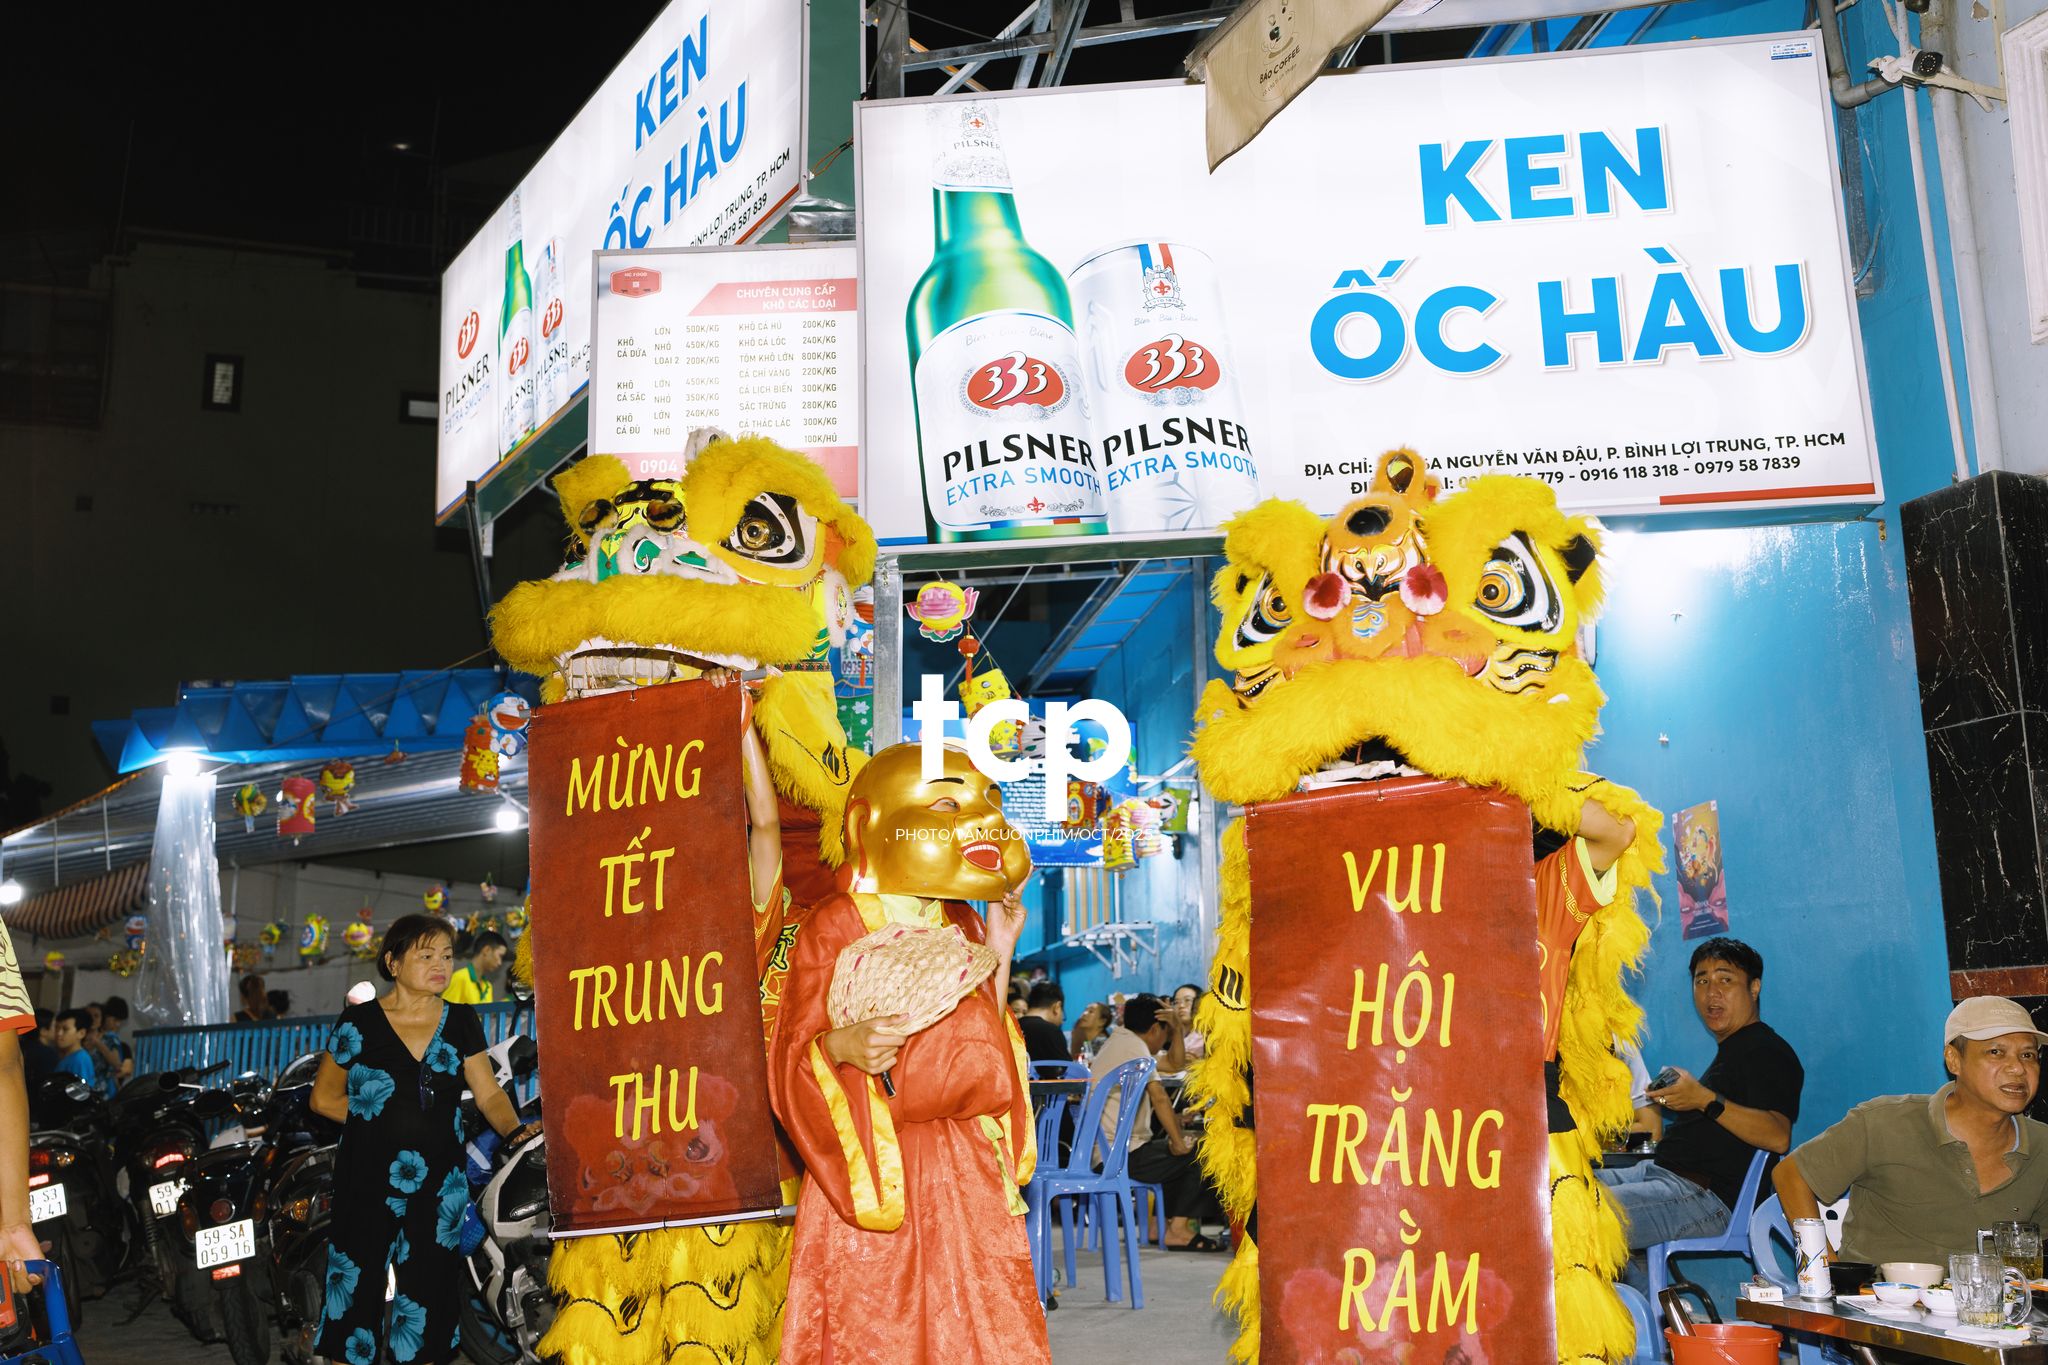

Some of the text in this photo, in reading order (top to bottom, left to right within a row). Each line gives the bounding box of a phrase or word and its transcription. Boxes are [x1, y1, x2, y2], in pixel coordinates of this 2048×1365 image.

[1274, 44, 1300, 74] COFFEE
[636, 14, 707, 151] KEN
[663, 81, 746, 226] HÀU
[770, 147, 790, 178] HCM
[1419, 126, 1668, 226] KEN
[738, 208, 751, 230] 587
[753, 193, 768, 215] 839
[736, 282, 836, 298] CHUYÊN CUNG CẤP
[811, 298, 836, 310] LOẠI
[802, 319, 836, 329] 200K/KG
[1310, 247, 1806, 379] ỐC HÀU
[617, 336, 634, 347] KHÔ
[674, 356, 680, 365] 2
[801, 352, 837, 361] 800K/KG
[802, 336, 836, 345] 240K/KG
[1136, 333, 1206, 388] 333
[445, 353, 490, 415] PILSNER
[617, 380, 634, 390] KHÔ
[802, 366, 837, 376] 220K/KG
[802, 383, 837, 393] 300K/KG
[978, 350, 1049, 405] 333
[616, 412, 633, 423] KHÔ
[802, 400, 837, 410] 280K/KG
[803, 417, 837, 427] 300K/KG
[943, 432, 1097, 483] PILSNER
[1102, 416, 1254, 468] PILSNER
[1304, 462, 1334, 480] ĐỊA
[1338, 457, 1373, 475] CHỈ:
[1447, 449, 1518, 470] NGUYỄN
[1522, 447, 1558, 465] VĂN
[1562, 445, 1602, 465] ĐẬU,
[1607, 447, 1620, 460] P.
[1625, 441, 1667, 459] BÌNH
[1671, 440, 1701, 458] LỢI
[1705, 437, 1771, 453] TRUNG,
[1775, 435, 1800, 449] TP.
[1804, 432, 1846, 447] HCM
[640, 459, 679, 474] 0904
[946, 466, 1102, 506] EXTRA SMOOTH
[1107, 450, 1259, 492] EXTRA SMOOTH
[1580, 467, 1619, 482] 0916
[1623, 465, 1648, 480] 118
[1652, 463, 1679, 478] 318
[1694, 460, 1734, 475] 0979
[1739, 457, 1759, 472] 58
[1764, 456, 1801, 471] 7839
[565, 735, 706, 818] MỪNG
[599, 826, 676, 918] TẾT
[1341, 842, 1447, 915] VUI
[568, 950, 724, 1032] TRUNG
[1346, 950, 1455, 1065] HỘI
[608, 1063, 701, 1143] THU
[1305, 1084, 1505, 1190] TRĂNG
[1337, 1207, 1481, 1336] RẰM
